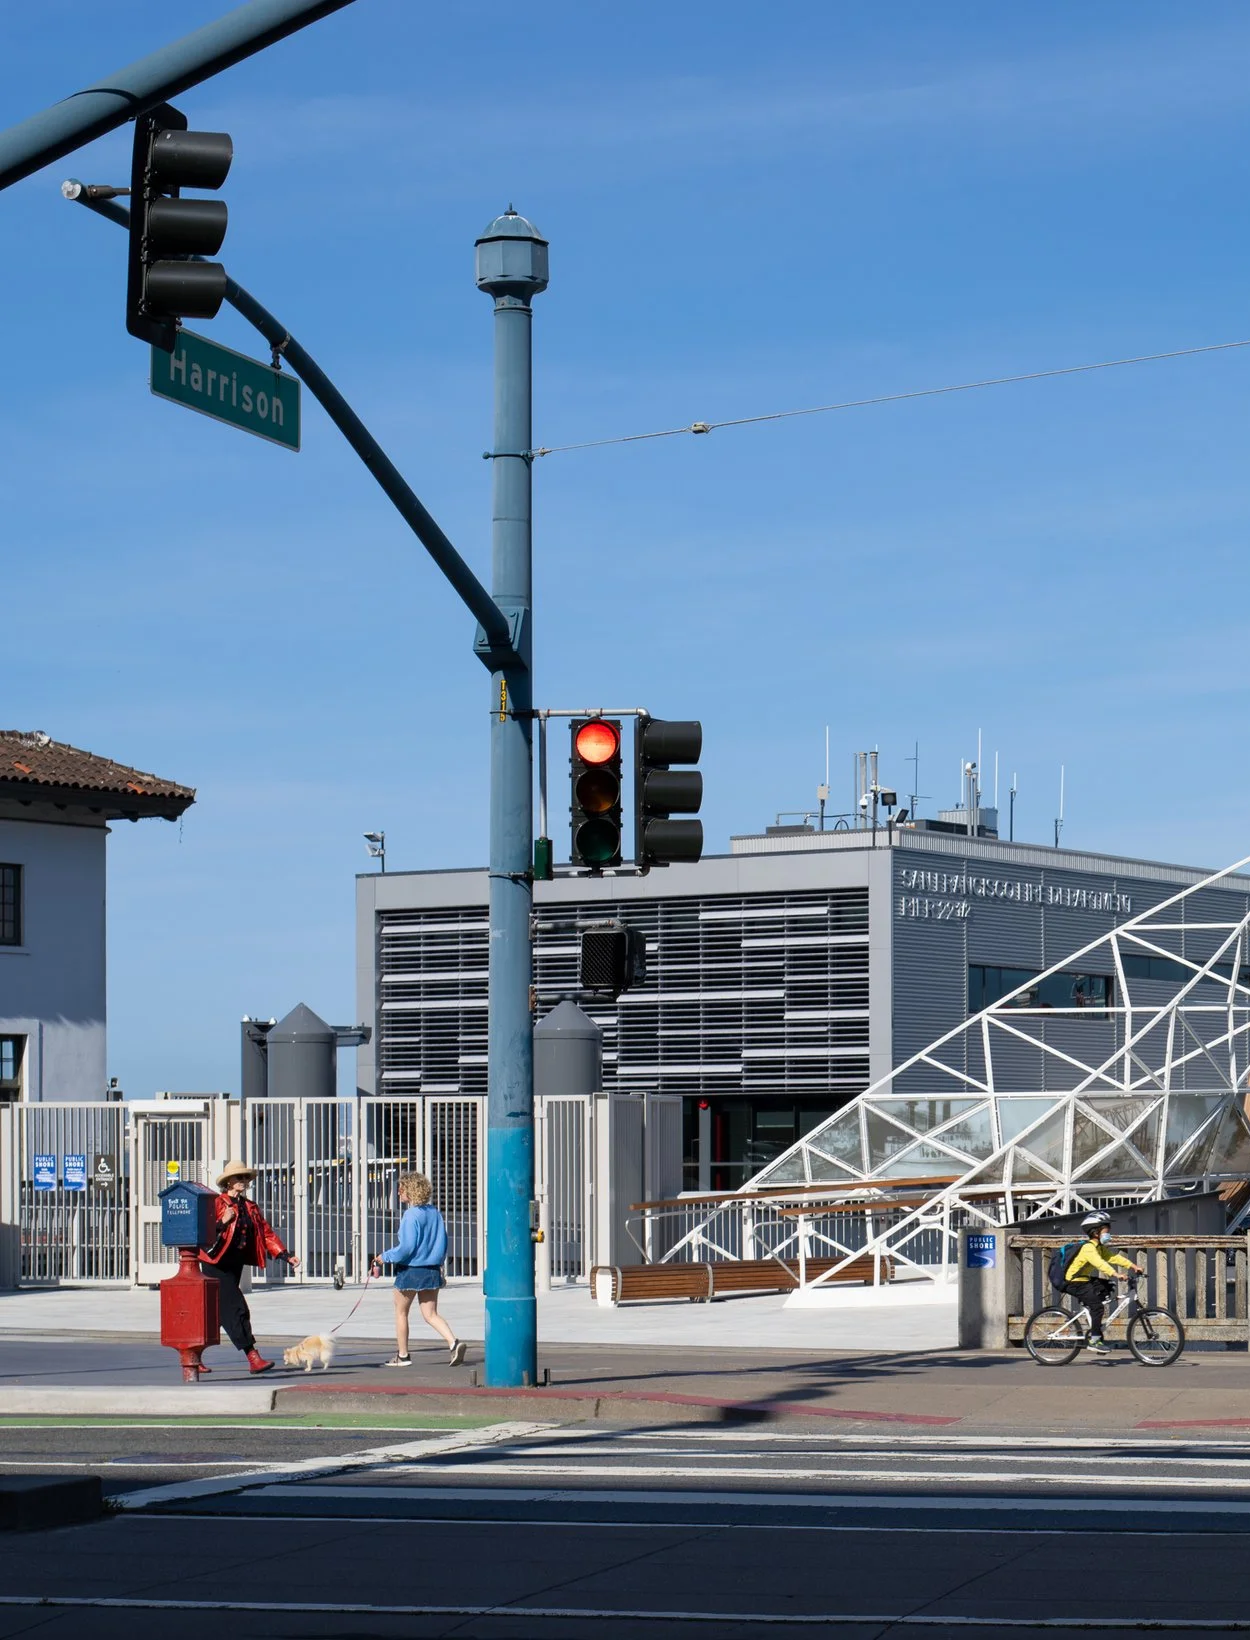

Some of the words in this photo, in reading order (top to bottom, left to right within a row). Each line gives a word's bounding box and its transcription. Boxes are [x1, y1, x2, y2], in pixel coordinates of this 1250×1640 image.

[170, 349, 284, 426] Harrison
[901, 896, 935, 917] PIER
[902, 869, 938, 892] SAN
[943, 874, 1014, 899] FRANCISCO
[1016, 882, 1044, 903] FIRE
[1048, 886, 1131, 913] DEPARTMENT
